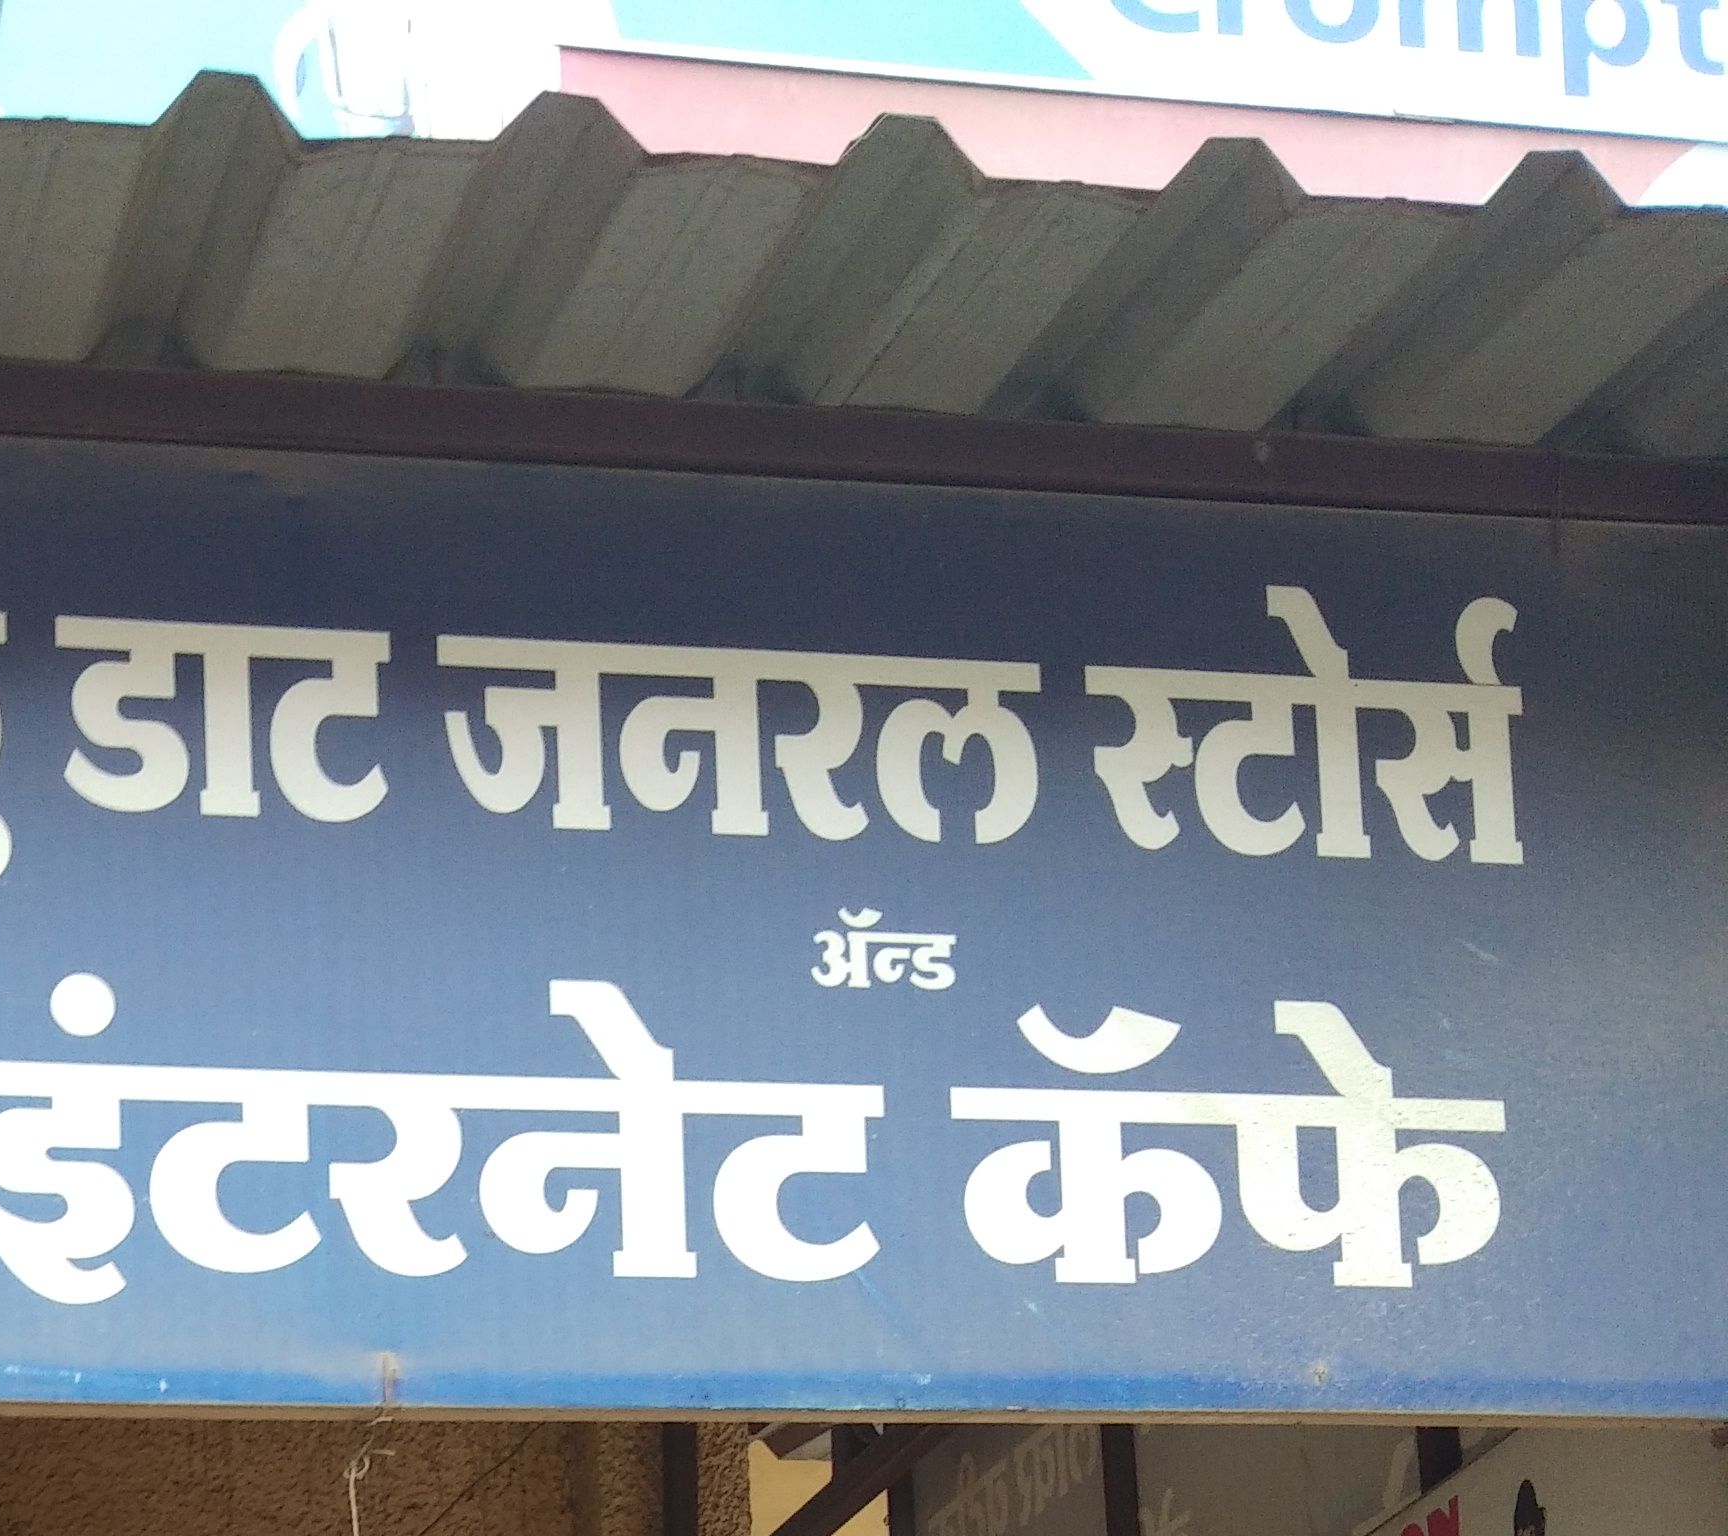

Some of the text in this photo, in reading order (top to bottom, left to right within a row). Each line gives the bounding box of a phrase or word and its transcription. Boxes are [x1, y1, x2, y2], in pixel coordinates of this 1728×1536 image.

[56, 614, 389, 822] डाट
[437, 634, 1042, 846] जनरल
[1084, 584, 1526, 865] स्टोर्स
[949, 1000, 1508, 1289] कॅफे
